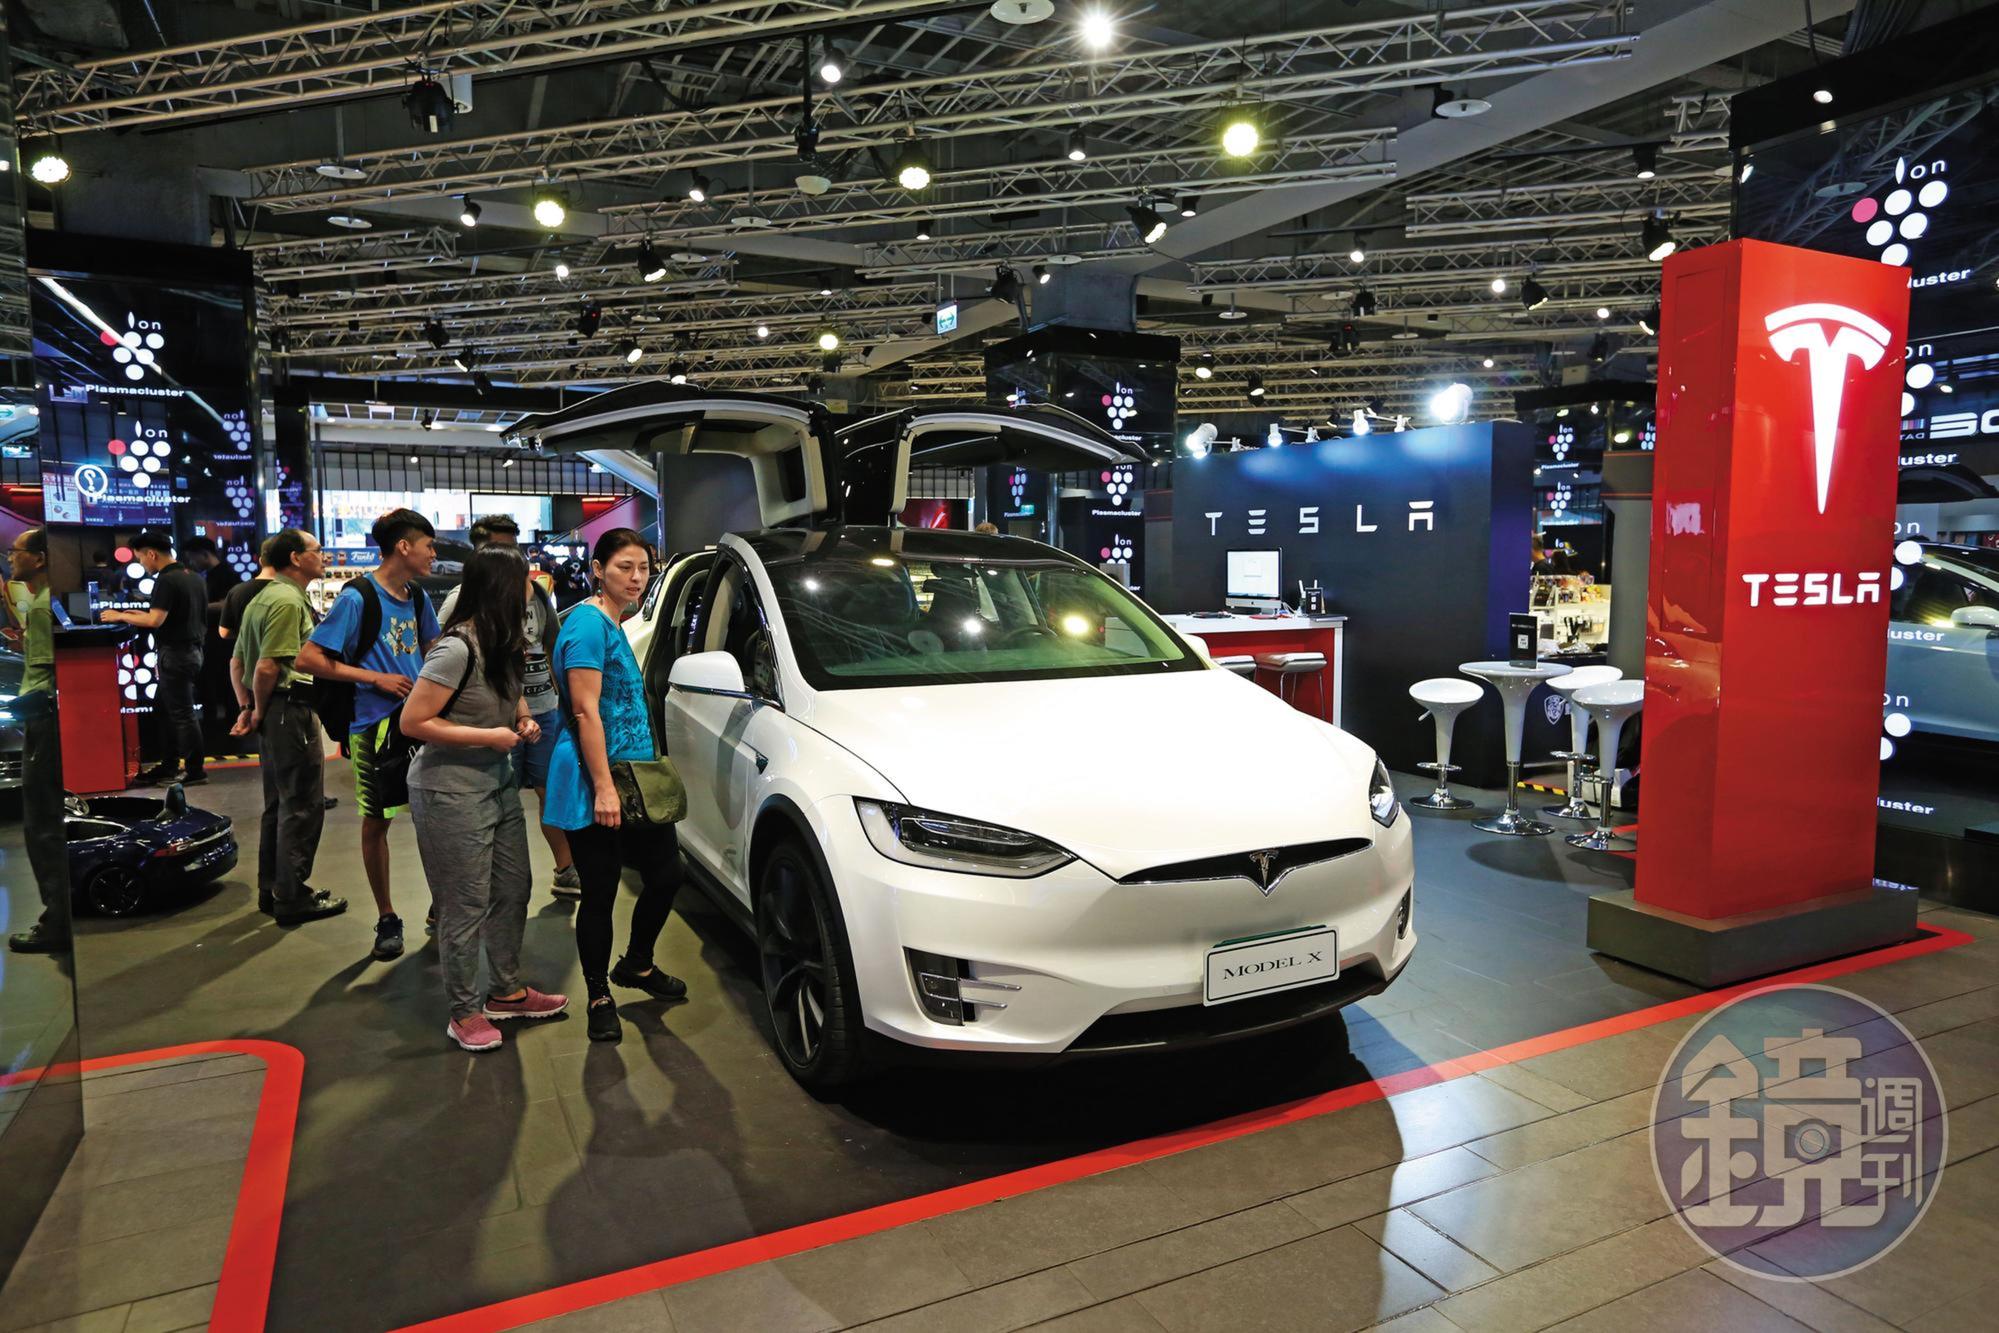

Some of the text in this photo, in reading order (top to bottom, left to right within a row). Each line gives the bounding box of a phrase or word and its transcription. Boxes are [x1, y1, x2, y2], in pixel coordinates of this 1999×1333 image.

[1905, 343, 1933, 360] on
[85, 384, 185, 398] Plasmacluster
[1091, 509, 1142, 517] Plasmacluster
[1205, 501, 1434, 536] TESLA
[1741, 572, 1881, 608] TESLA
[1223, 950, 1323, 980] MODEL X
